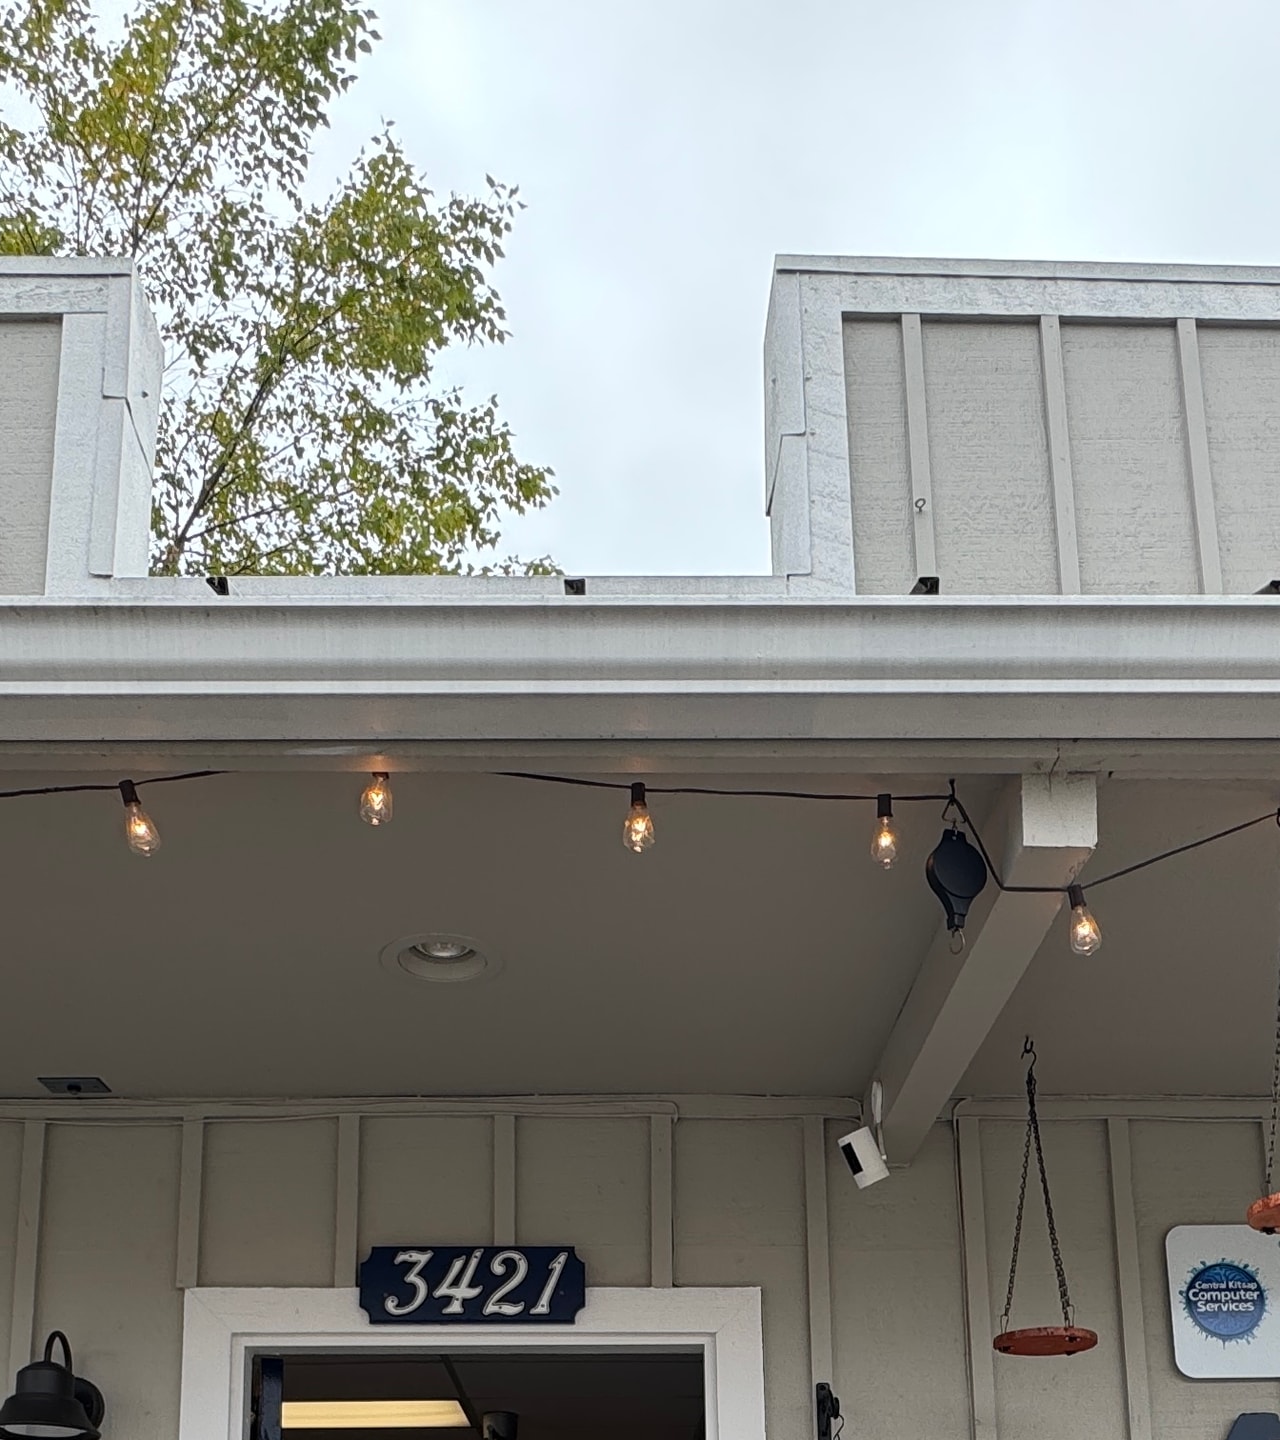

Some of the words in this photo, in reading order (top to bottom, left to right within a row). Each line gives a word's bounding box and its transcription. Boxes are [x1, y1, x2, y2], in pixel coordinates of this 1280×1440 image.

[384, 1248, 569, 1316] 3421
[1195, 1281, 1226, 1289] Central
[1228, 1280, 1257, 1290] Kitsap
[1188, 1288, 1260, 1302] Computer
[1196, 1301, 1255, 1312] Services
